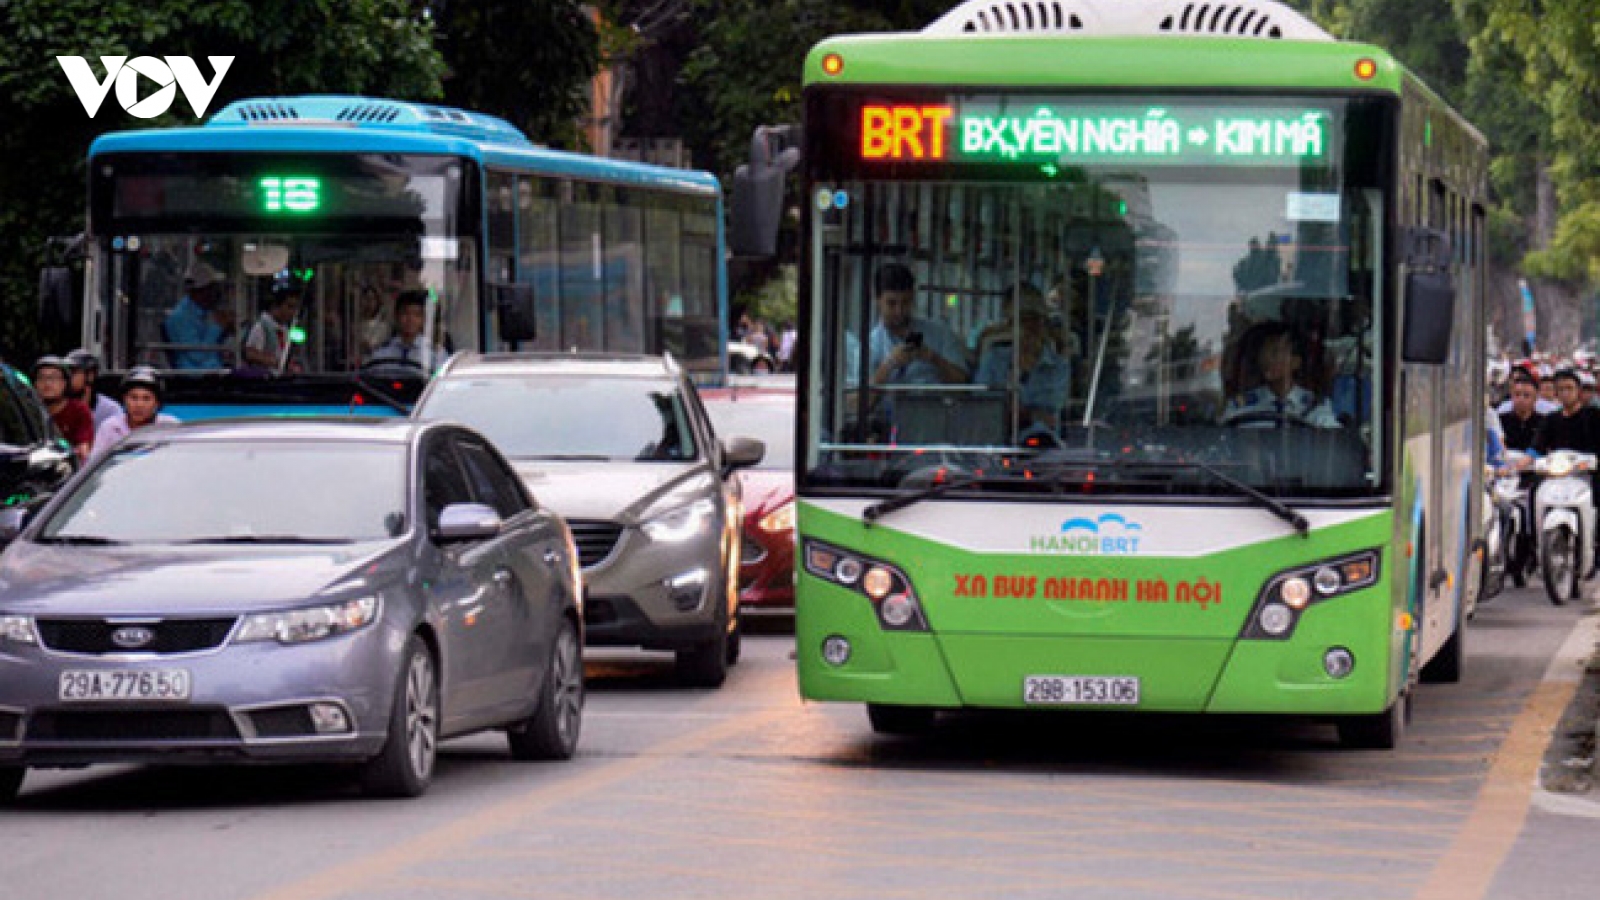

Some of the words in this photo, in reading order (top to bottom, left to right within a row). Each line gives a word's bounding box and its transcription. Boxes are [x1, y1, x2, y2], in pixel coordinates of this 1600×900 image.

[861, 106, 952, 158] BRT
[1216, 118, 1271, 154] KIM
[1275, 111, 1322, 154] MÃ
[993, 575, 1037, 598] BUS
[1136, 573, 1168, 602] HÀ
[1175, 576, 1222, 610] NỘI
